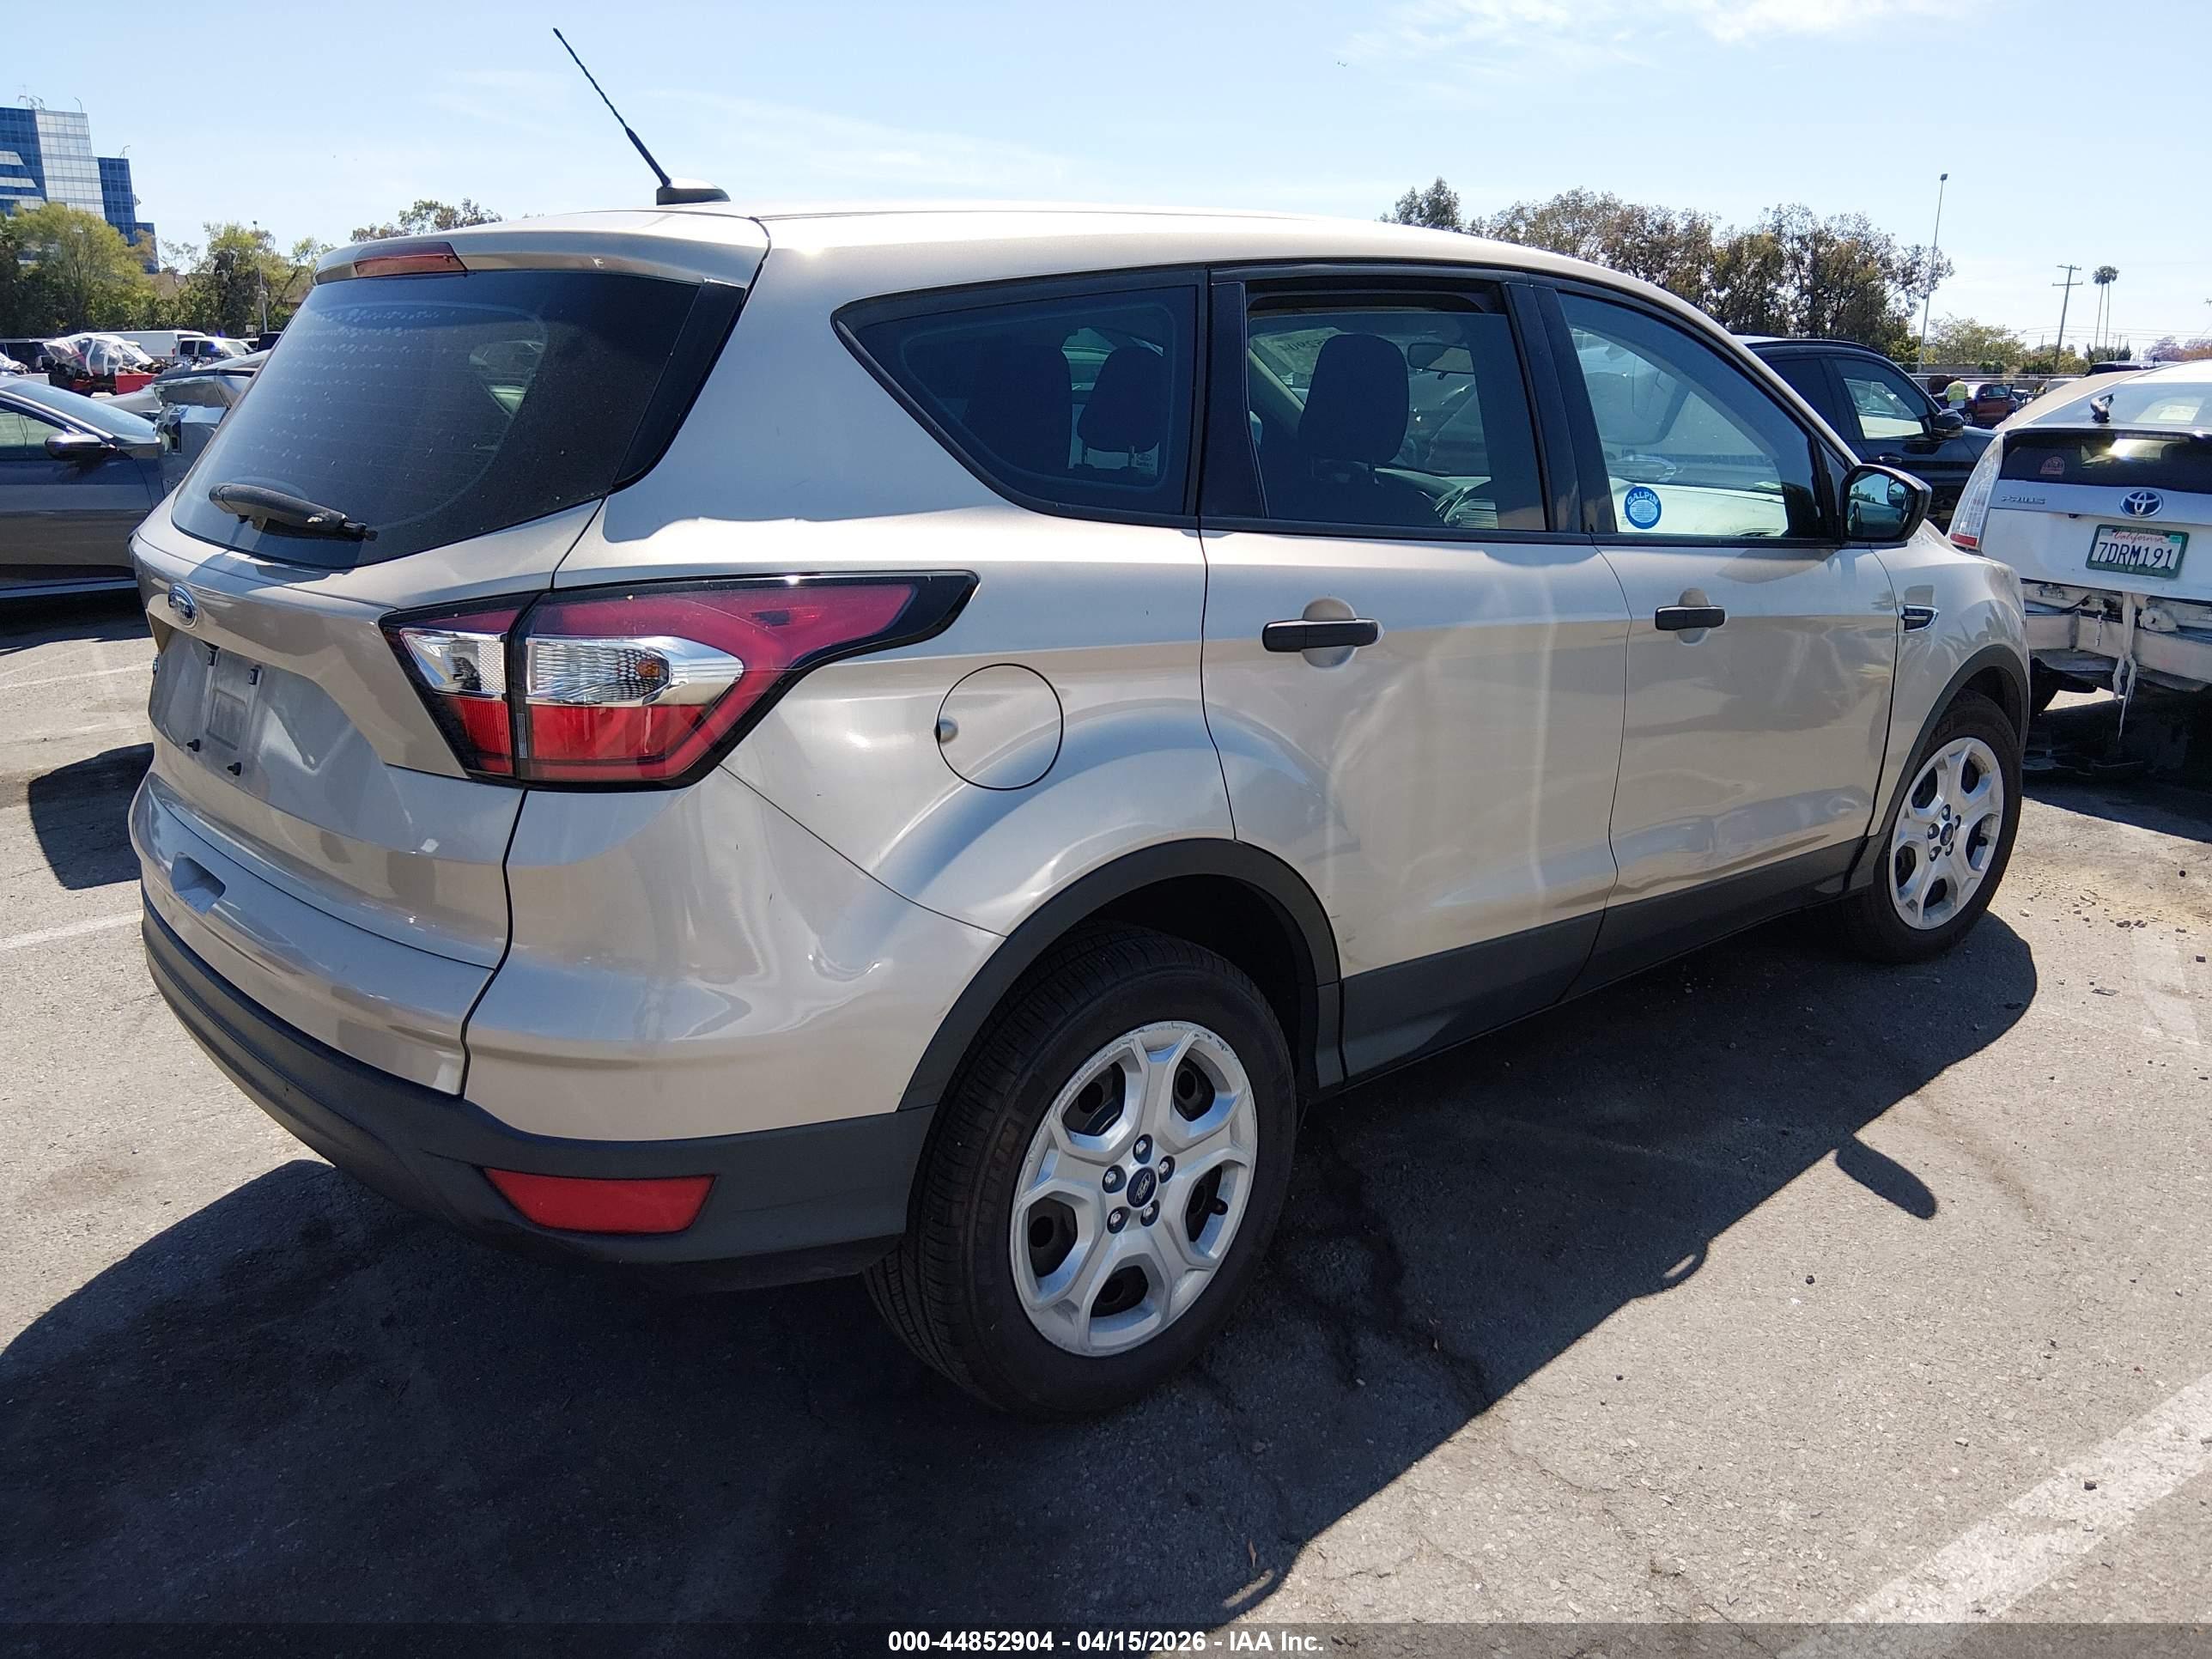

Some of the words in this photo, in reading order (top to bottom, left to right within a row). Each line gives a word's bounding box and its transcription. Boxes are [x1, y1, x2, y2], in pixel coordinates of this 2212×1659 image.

[1627, 491, 1658, 506] GALPIN
[2001, 495, 2045, 505] PRIUS
[2113, 530, 2167, 544] California
[2098, 542, 2173, 570] 7DRM191
